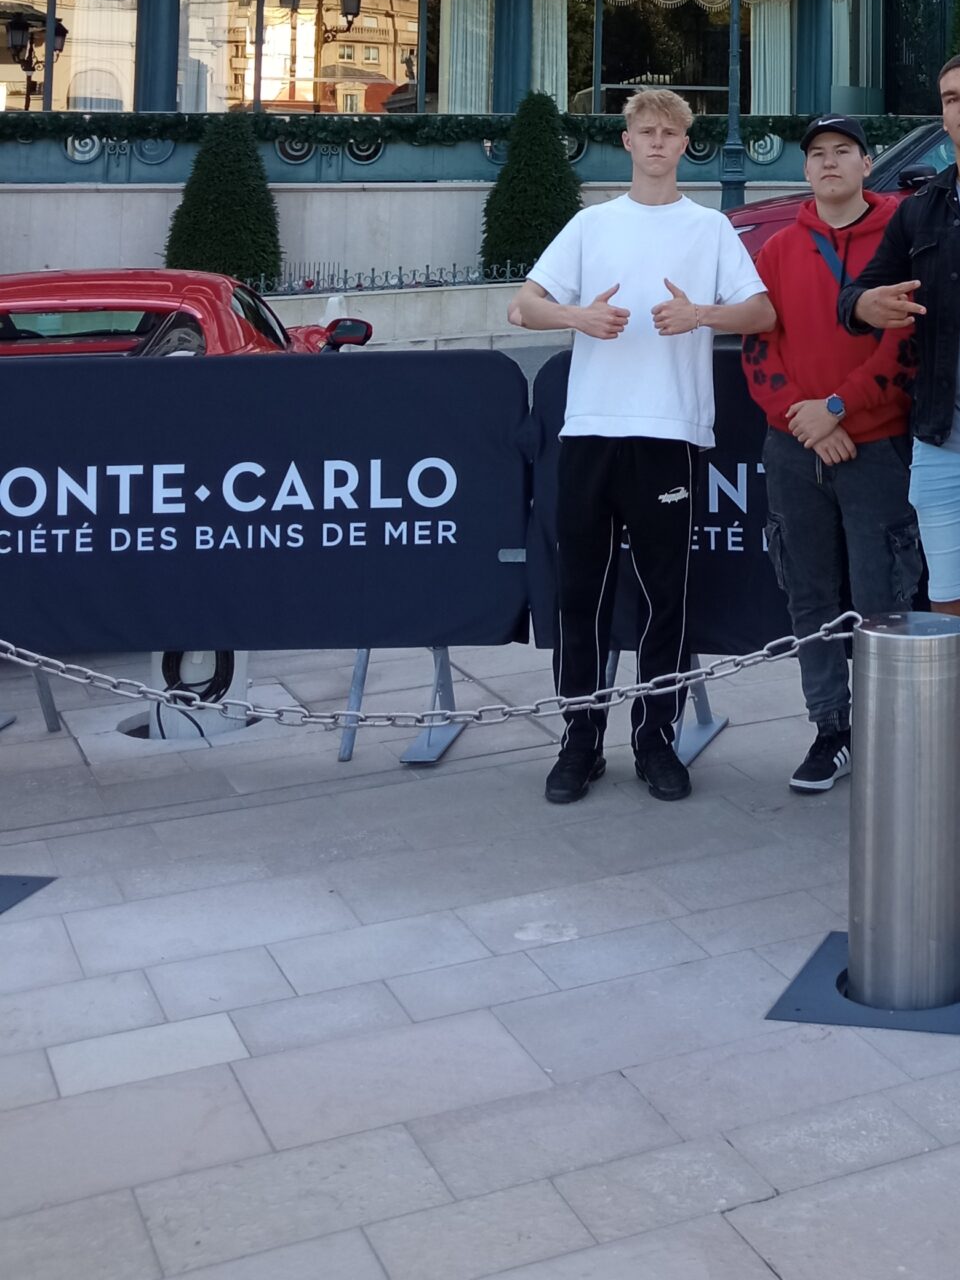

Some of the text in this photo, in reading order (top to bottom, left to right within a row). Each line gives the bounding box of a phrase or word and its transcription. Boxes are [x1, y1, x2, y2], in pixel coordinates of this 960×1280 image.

[0, 463, 186, 517] ONTE
[110, 526, 178, 552] DES
[195, 523, 304, 550] BAINS
[322, 522, 367, 547] DE
[384, 520, 457, 545] MER
